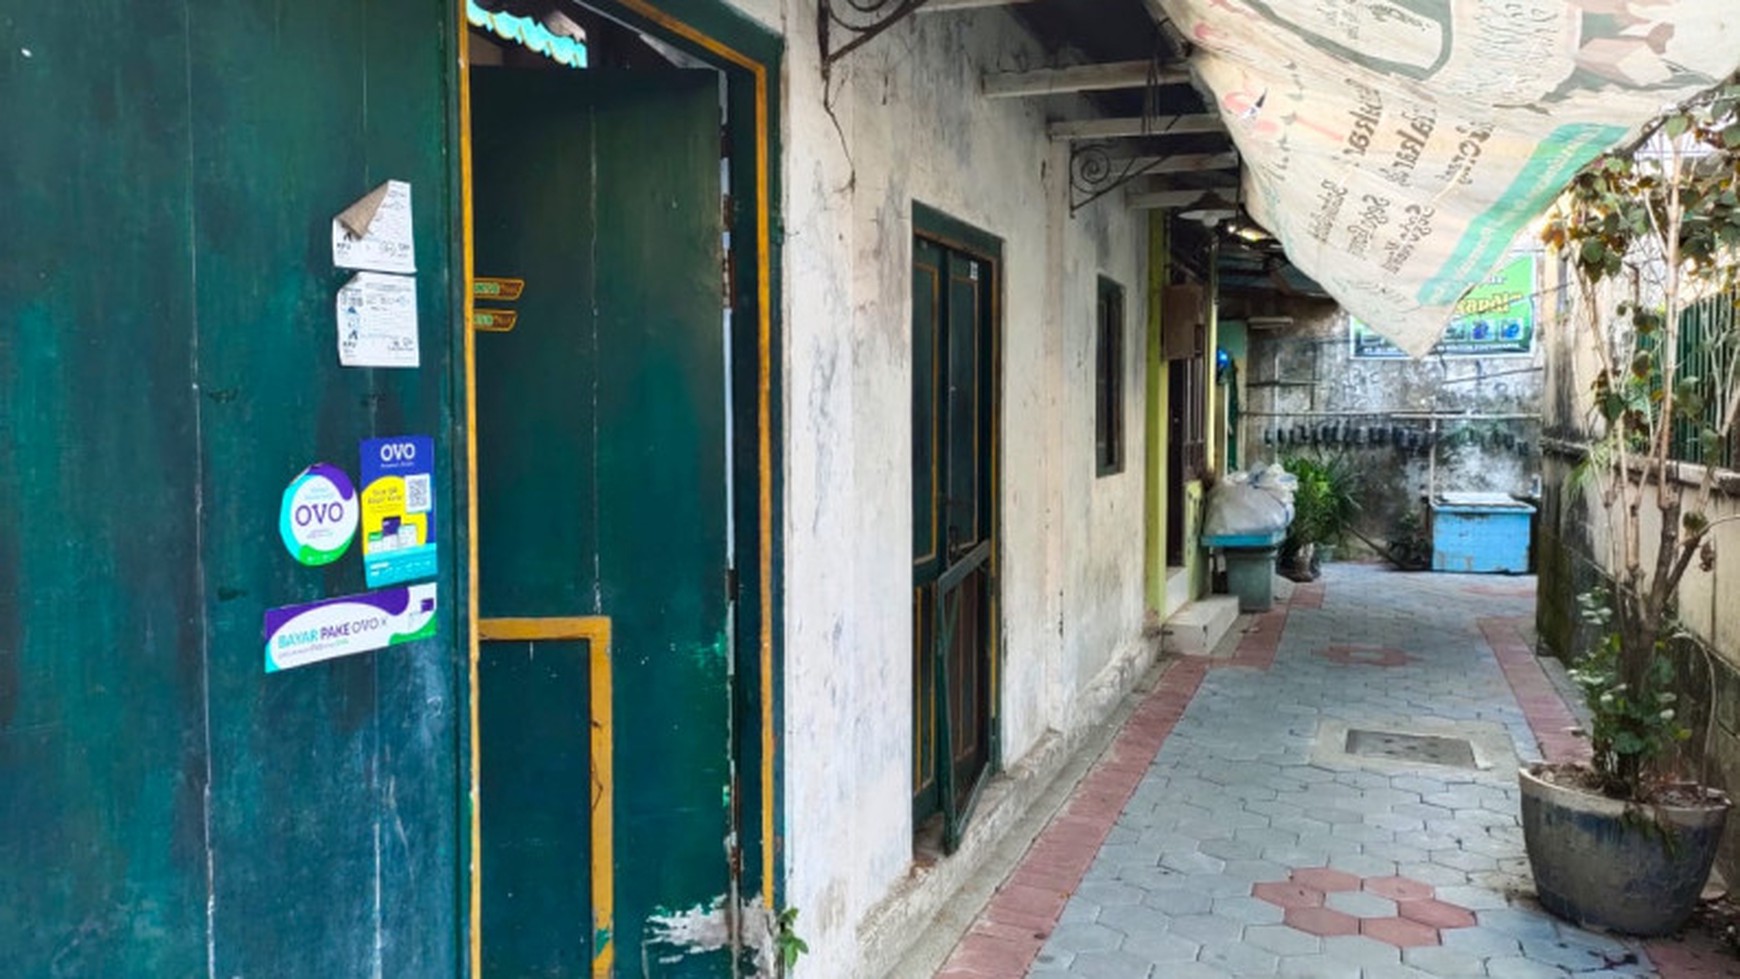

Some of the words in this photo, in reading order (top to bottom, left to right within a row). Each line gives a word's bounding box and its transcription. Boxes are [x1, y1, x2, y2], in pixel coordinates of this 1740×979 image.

[380, 443, 415, 462] OVO
[295, 501, 344, 527] OVO
[278, 628, 318, 649] BAYAR
[320, 621, 350, 640] PAKE
[352, 617, 379, 634] OVO
